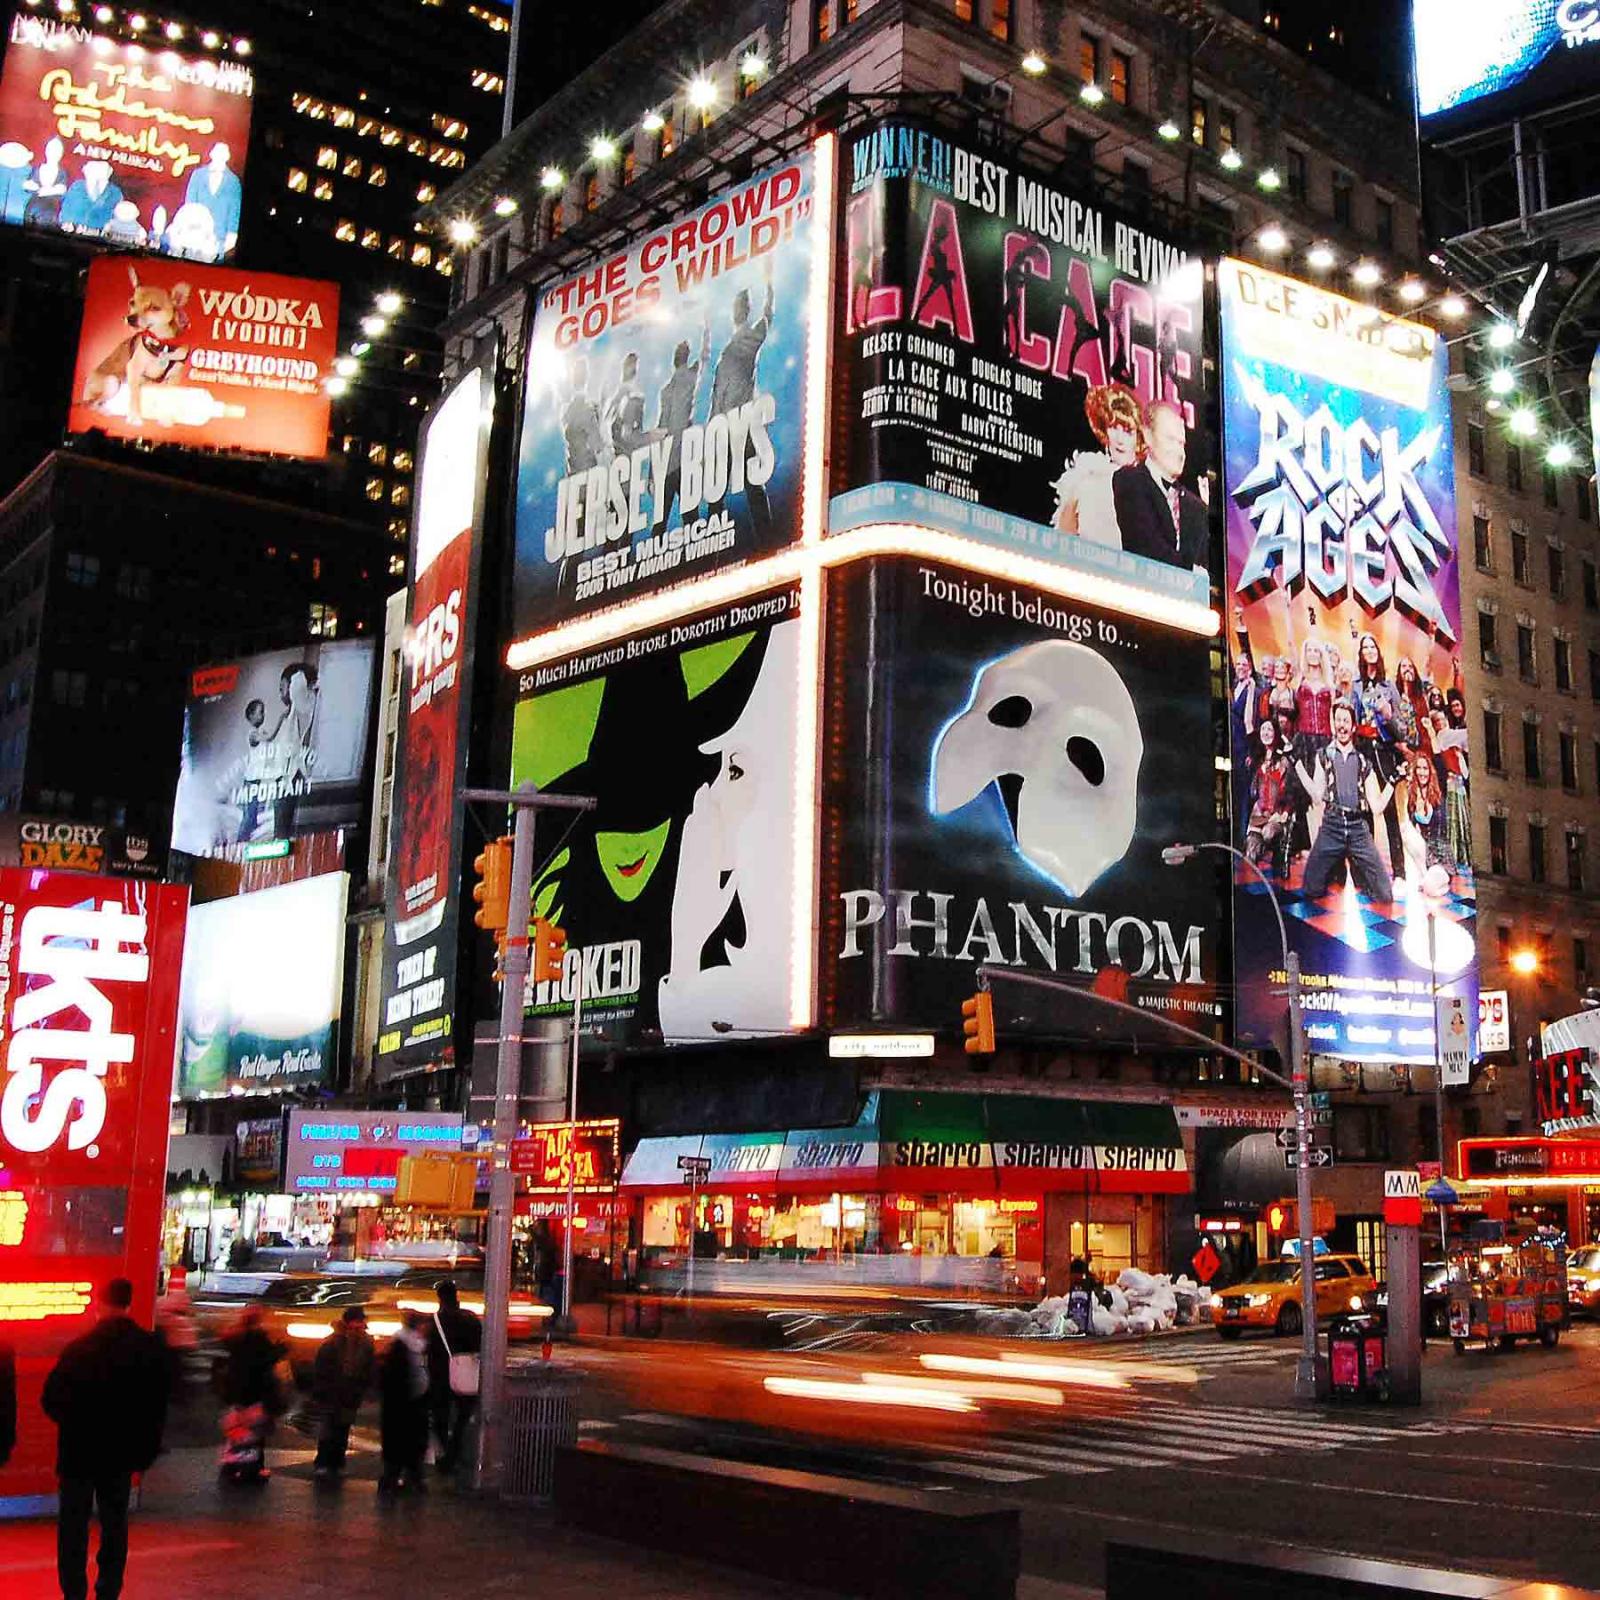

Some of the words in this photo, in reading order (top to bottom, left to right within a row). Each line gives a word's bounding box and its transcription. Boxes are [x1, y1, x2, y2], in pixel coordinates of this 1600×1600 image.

[39, 68, 214, 135] Addams
[94, 63, 172, 92] The
[52, 103, 200, 178] Family
[72, 143, 86, 155] A
[86, 145, 112, 161] NEW
[112, 150, 164, 173] MUSICAL
[853, 127, 951, 182] WINNER!
[640, 167, 801, 275] CROWD
[954, 147, 1009, 217] BEST
[1017, 176, 1108, 263] MUSICAL
[846, 192, 975, 344] LA
[199, 285, 323, 329] WÓDKA
[555, 275, 661, 350] GOES
[191, 348, 319, 380] GREYHOUND
[862, 332, 902, 359] KELSEY
[907, 334, 955, 368] GRAMMER
[861, 394, 890, 418] JERRY
[896, 394, 938, 421] HERMAN
[888, 358, 904, 381] LA
[911, 361, 939, 391] CAGE
[945, 374, 968, 400] AUX
[972, 383, 1013, 417] FOLLES
[971, 357, 1011, 389] DOUGLAS
[1015, 373, 1044, 401] HODGE
[961, 412, 996, 441] HARVEY
[999, 426, 1043, 458] FIERSTEIN
[1231, 358, 1450, 548] ROCK
[544, 434, 674, 564] JERSEY
[680, 392, 776, 516] BOYS
[577, 547, 631, 583] BEST
[636, 509, 736, 563] MUSICAL
[607, 566, 636, 591] TONY
[636, 549, 682, 580] AWARD
[685, 528, 736, 563] WINNER
[1236, 480, 1457, 641] AGES
[918, 567, 1005, 618] Tonight
[1012, 590, 1092, 642] belongs
[535, 665, 567, 687] MUCH
[569, 651, 625, 678] HAPPENED
[626, 638, 667, 659] BEFORE
[671, 615, 729, 643] DOROTHY
[730, 596, 786, 628] DROPPED
[232, 779, 312, 804] IMPORTANT
[20, 842, 104, 872] DAZE
[21, 822, 104, 846] GLORY
[840, 888, 1205, 984] PHANTOM
[498, 939, 641, 1007] CKED
[0, 900, 149, 1153] tkts
[1146, 996, 1181, 1010] MAJESTIC
[1183, 1000, 1213, 1015] THEATRE
[1199, 1108, 1234, 1118] SPACE
[1236, 1109, 1258, 1119] FOR
[1261, 1110, 1287, 1119] RENT
[711, 1145, 771, 1171] sbarro
[792, 1142, 864, 1168] sbarro
[894, 1138, 981, 1167] sbarro
[1003, 1142, 1084, 1169] sbarro
[1103, 1145, 1176, 1171] sbarro
